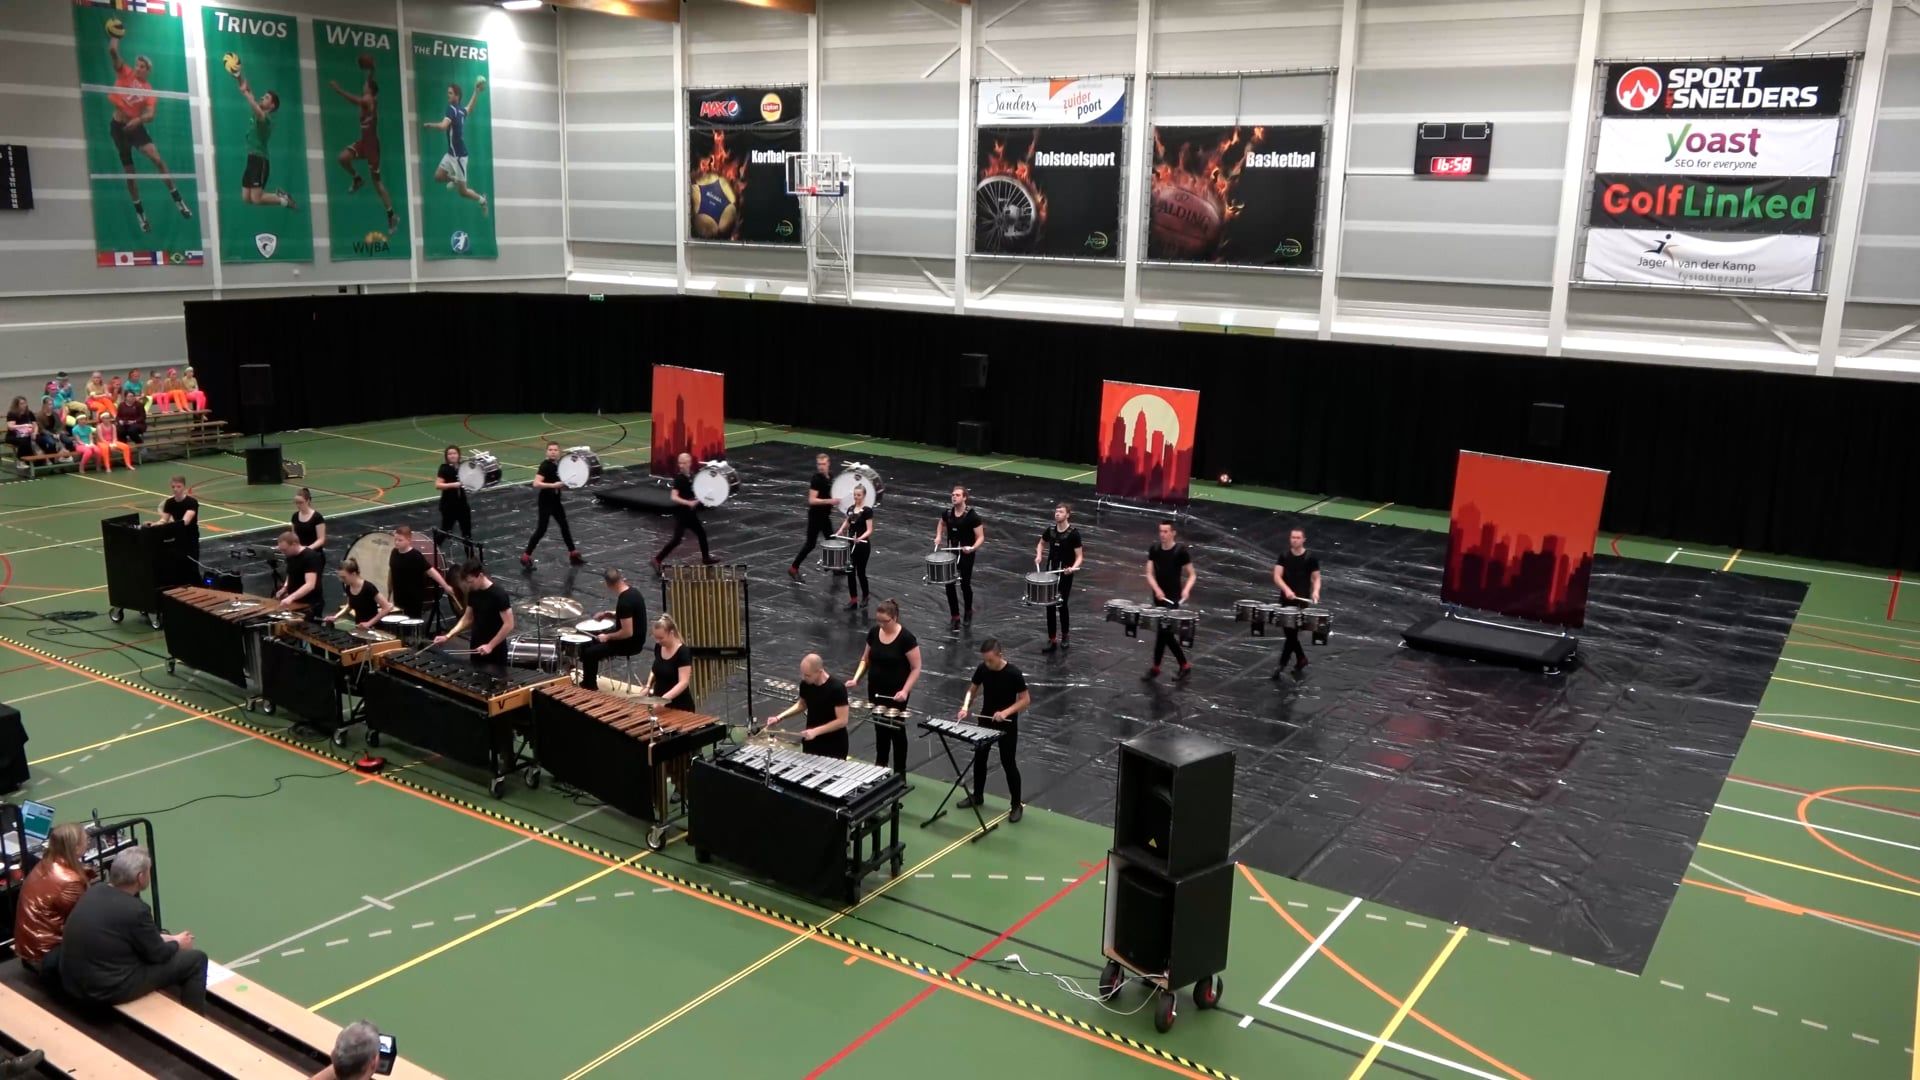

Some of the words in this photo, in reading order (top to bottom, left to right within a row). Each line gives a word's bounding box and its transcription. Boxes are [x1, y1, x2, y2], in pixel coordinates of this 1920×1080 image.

[214, 11, 288, 38] TRIVOS
[326, 24, 391, 50] WYBA
[413, 45, 431, 55] THE
[433, 40, 488, 61] FLYERS
[1667, 67, 1763, 89] SPORT
[987, 93, 1037, 114] Sanders
[1063, 91, 1092, 110] zuider
[1672, 86, 1819, 109] SNELDERS
[700, 101, 729, 118] MAX
[1077, 99, 1102, 120] poort
[1665, 123, 1762, 162] yoast
[752, 150, 785, 164] Korfbal
[1035, 151, 1116, 168] Rolstoelsport
[1246, 151, 1316, 169] Basketbal
[1437, 157, 1472, 171] 16:58
[1675, 159, 1694, 168] SEO
[1697, 159, 1711, 168] for
[1713, 160, 1757, 170] everyone
[1604, 183, 1816, 220] GolfLinked
[1637, 257, 1667, 268] Jager
[1678, 260, 1698, 269] van
[1701, 260, 1719, 270] der
[1723, 260, 1756, 273] Kamp
[1678, 271, 1754, 285] fysiotherapie
